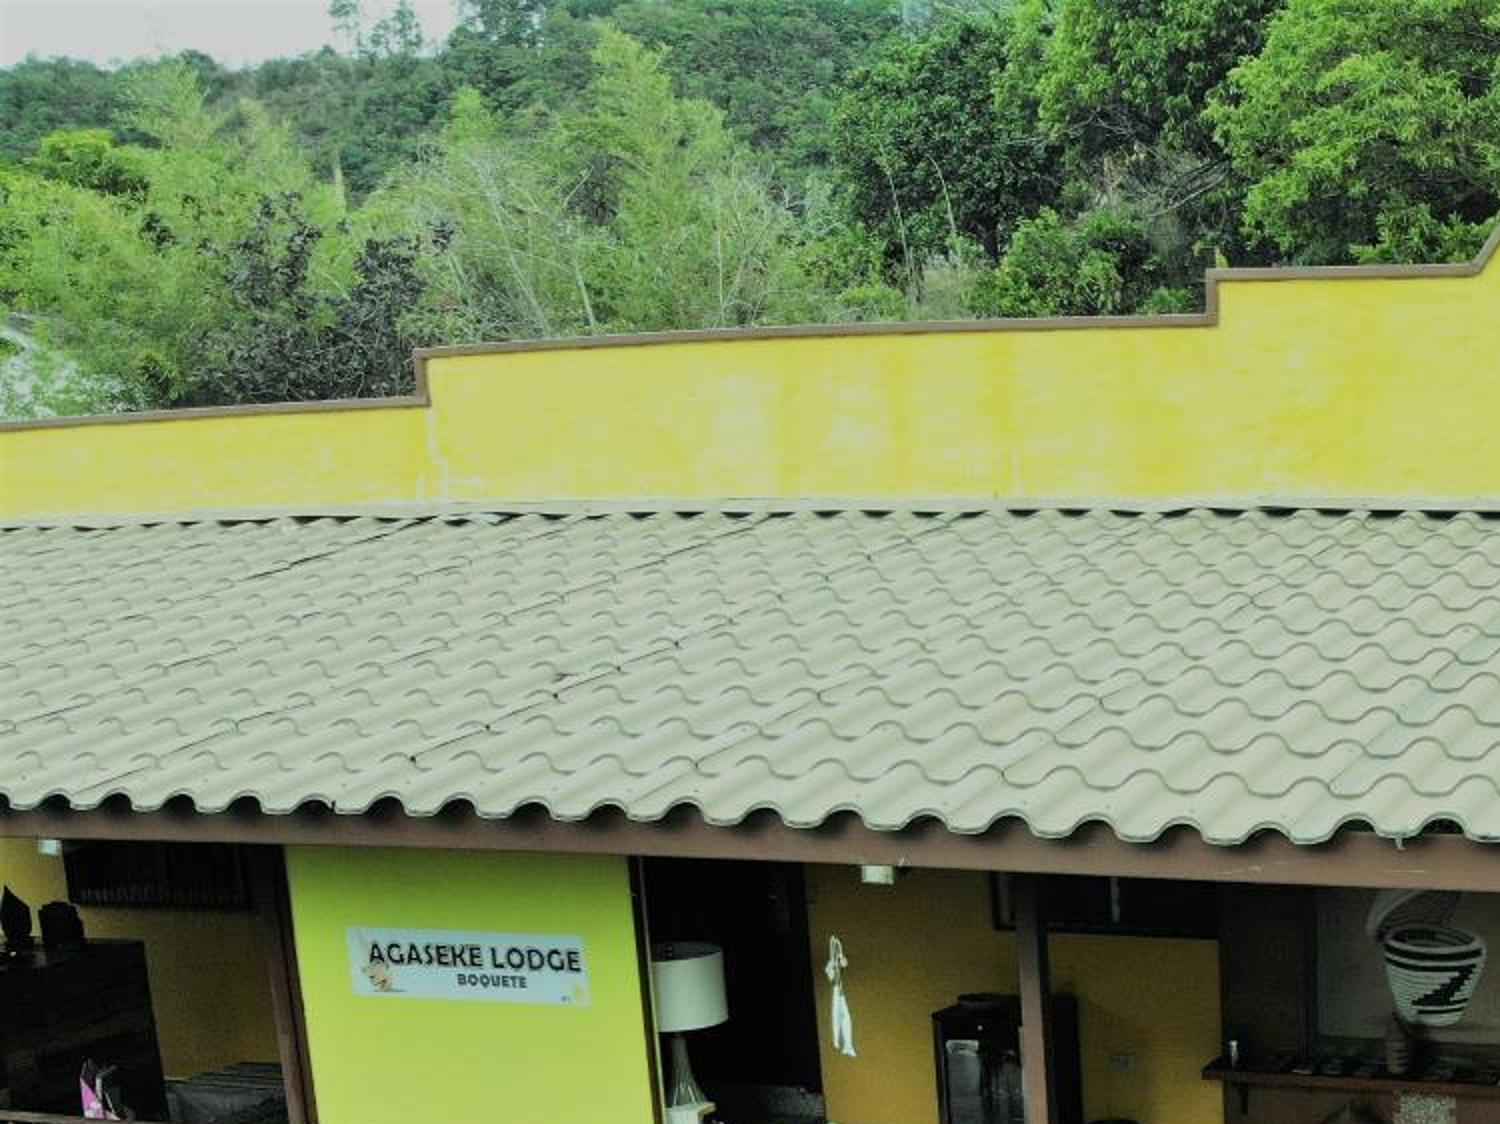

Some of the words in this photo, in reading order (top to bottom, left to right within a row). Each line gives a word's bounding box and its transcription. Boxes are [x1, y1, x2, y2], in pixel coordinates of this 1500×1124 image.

[369, 942, 482, 967] AGASEKE
[491, 946, 582, 972] LODGE
[457, 973, 528, 989] BOQUETE
